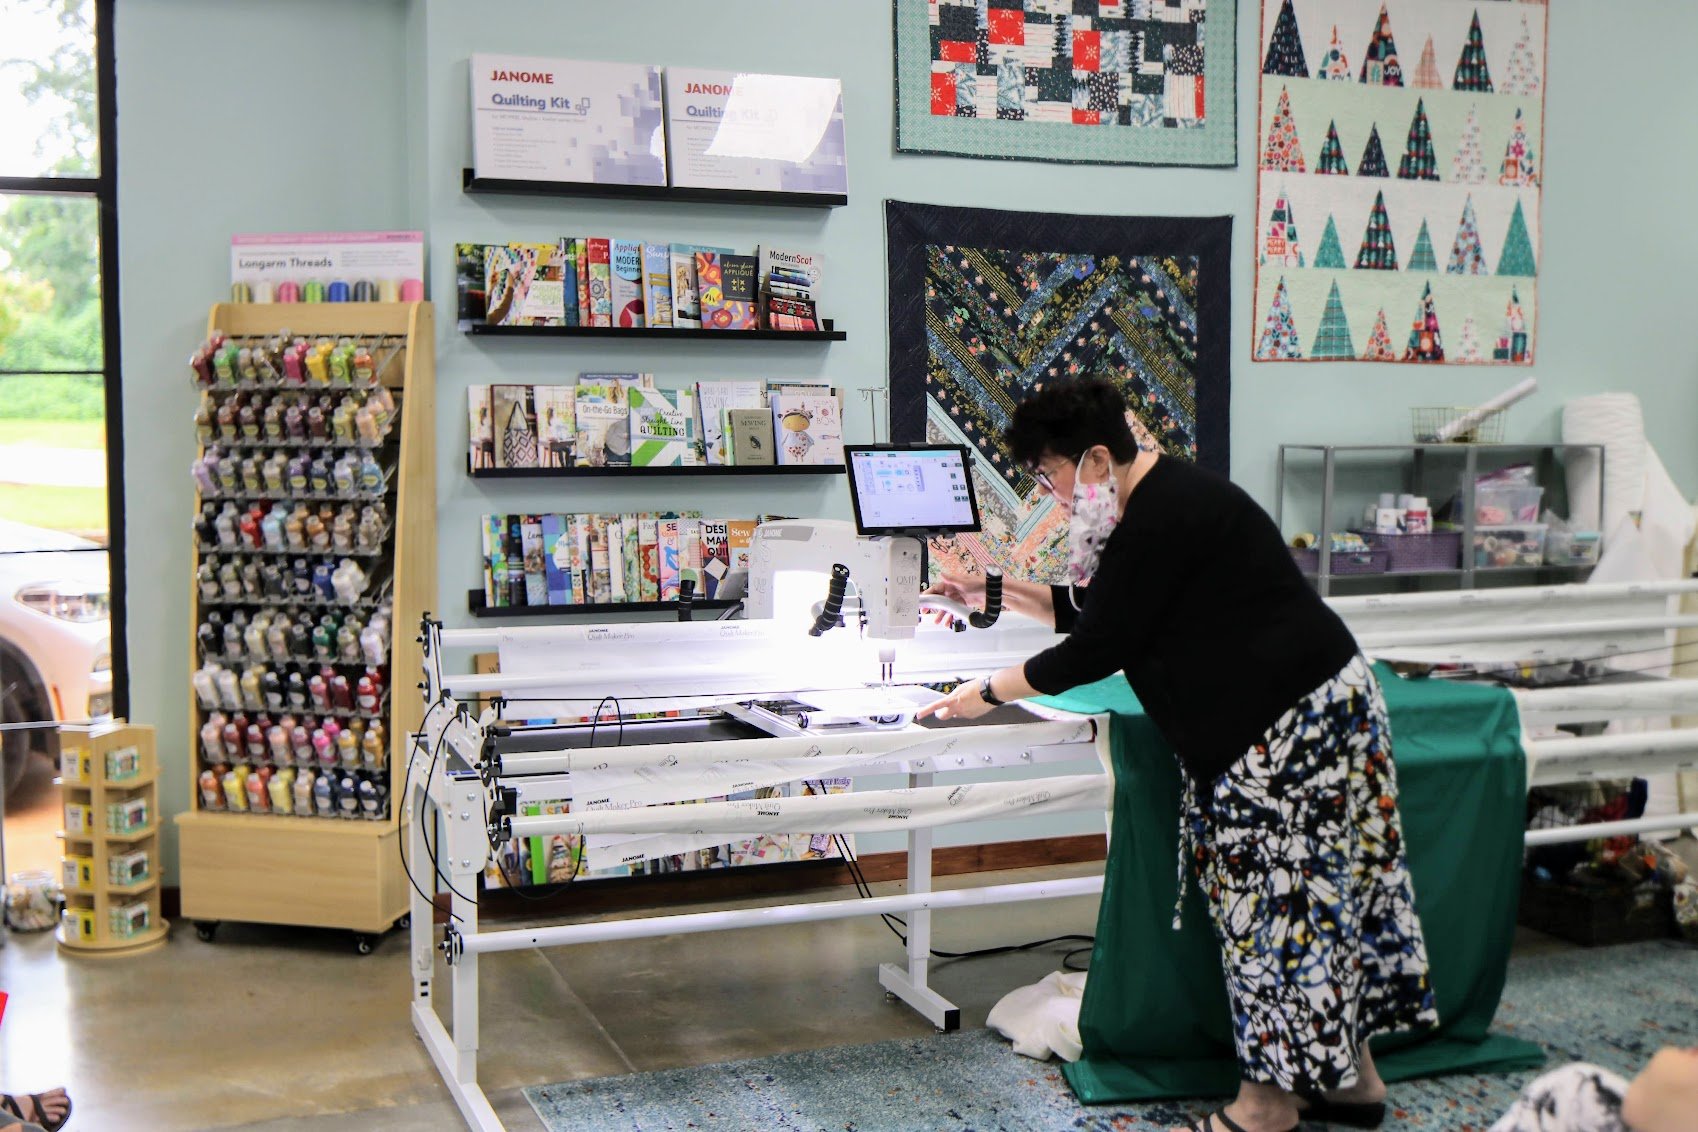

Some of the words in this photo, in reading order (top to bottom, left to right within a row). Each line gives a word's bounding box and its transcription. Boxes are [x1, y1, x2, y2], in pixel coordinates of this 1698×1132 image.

[1384, 65, 1400, 76] JOY
[491, 70, 554, 84] JANOME
[492, 94, 546, 110] Quilting
[551, 97, 570, 109] Kit
[238, 258, 286, 270] Longarm
[291, 257, 332, 268] Threads
[583, 404, 612, 413] On-the-Go
[613, 405, 628, 416] Bags
[659, 408, 683, 417] Creative
[641, 416, 668, 426] Straight
[640, 425, 685, 437] QUILTING
[731, 528, 750, 537] Sew
[586, 798, 610, 806] JANOME
[621, 854, 645, 863] JANOME
